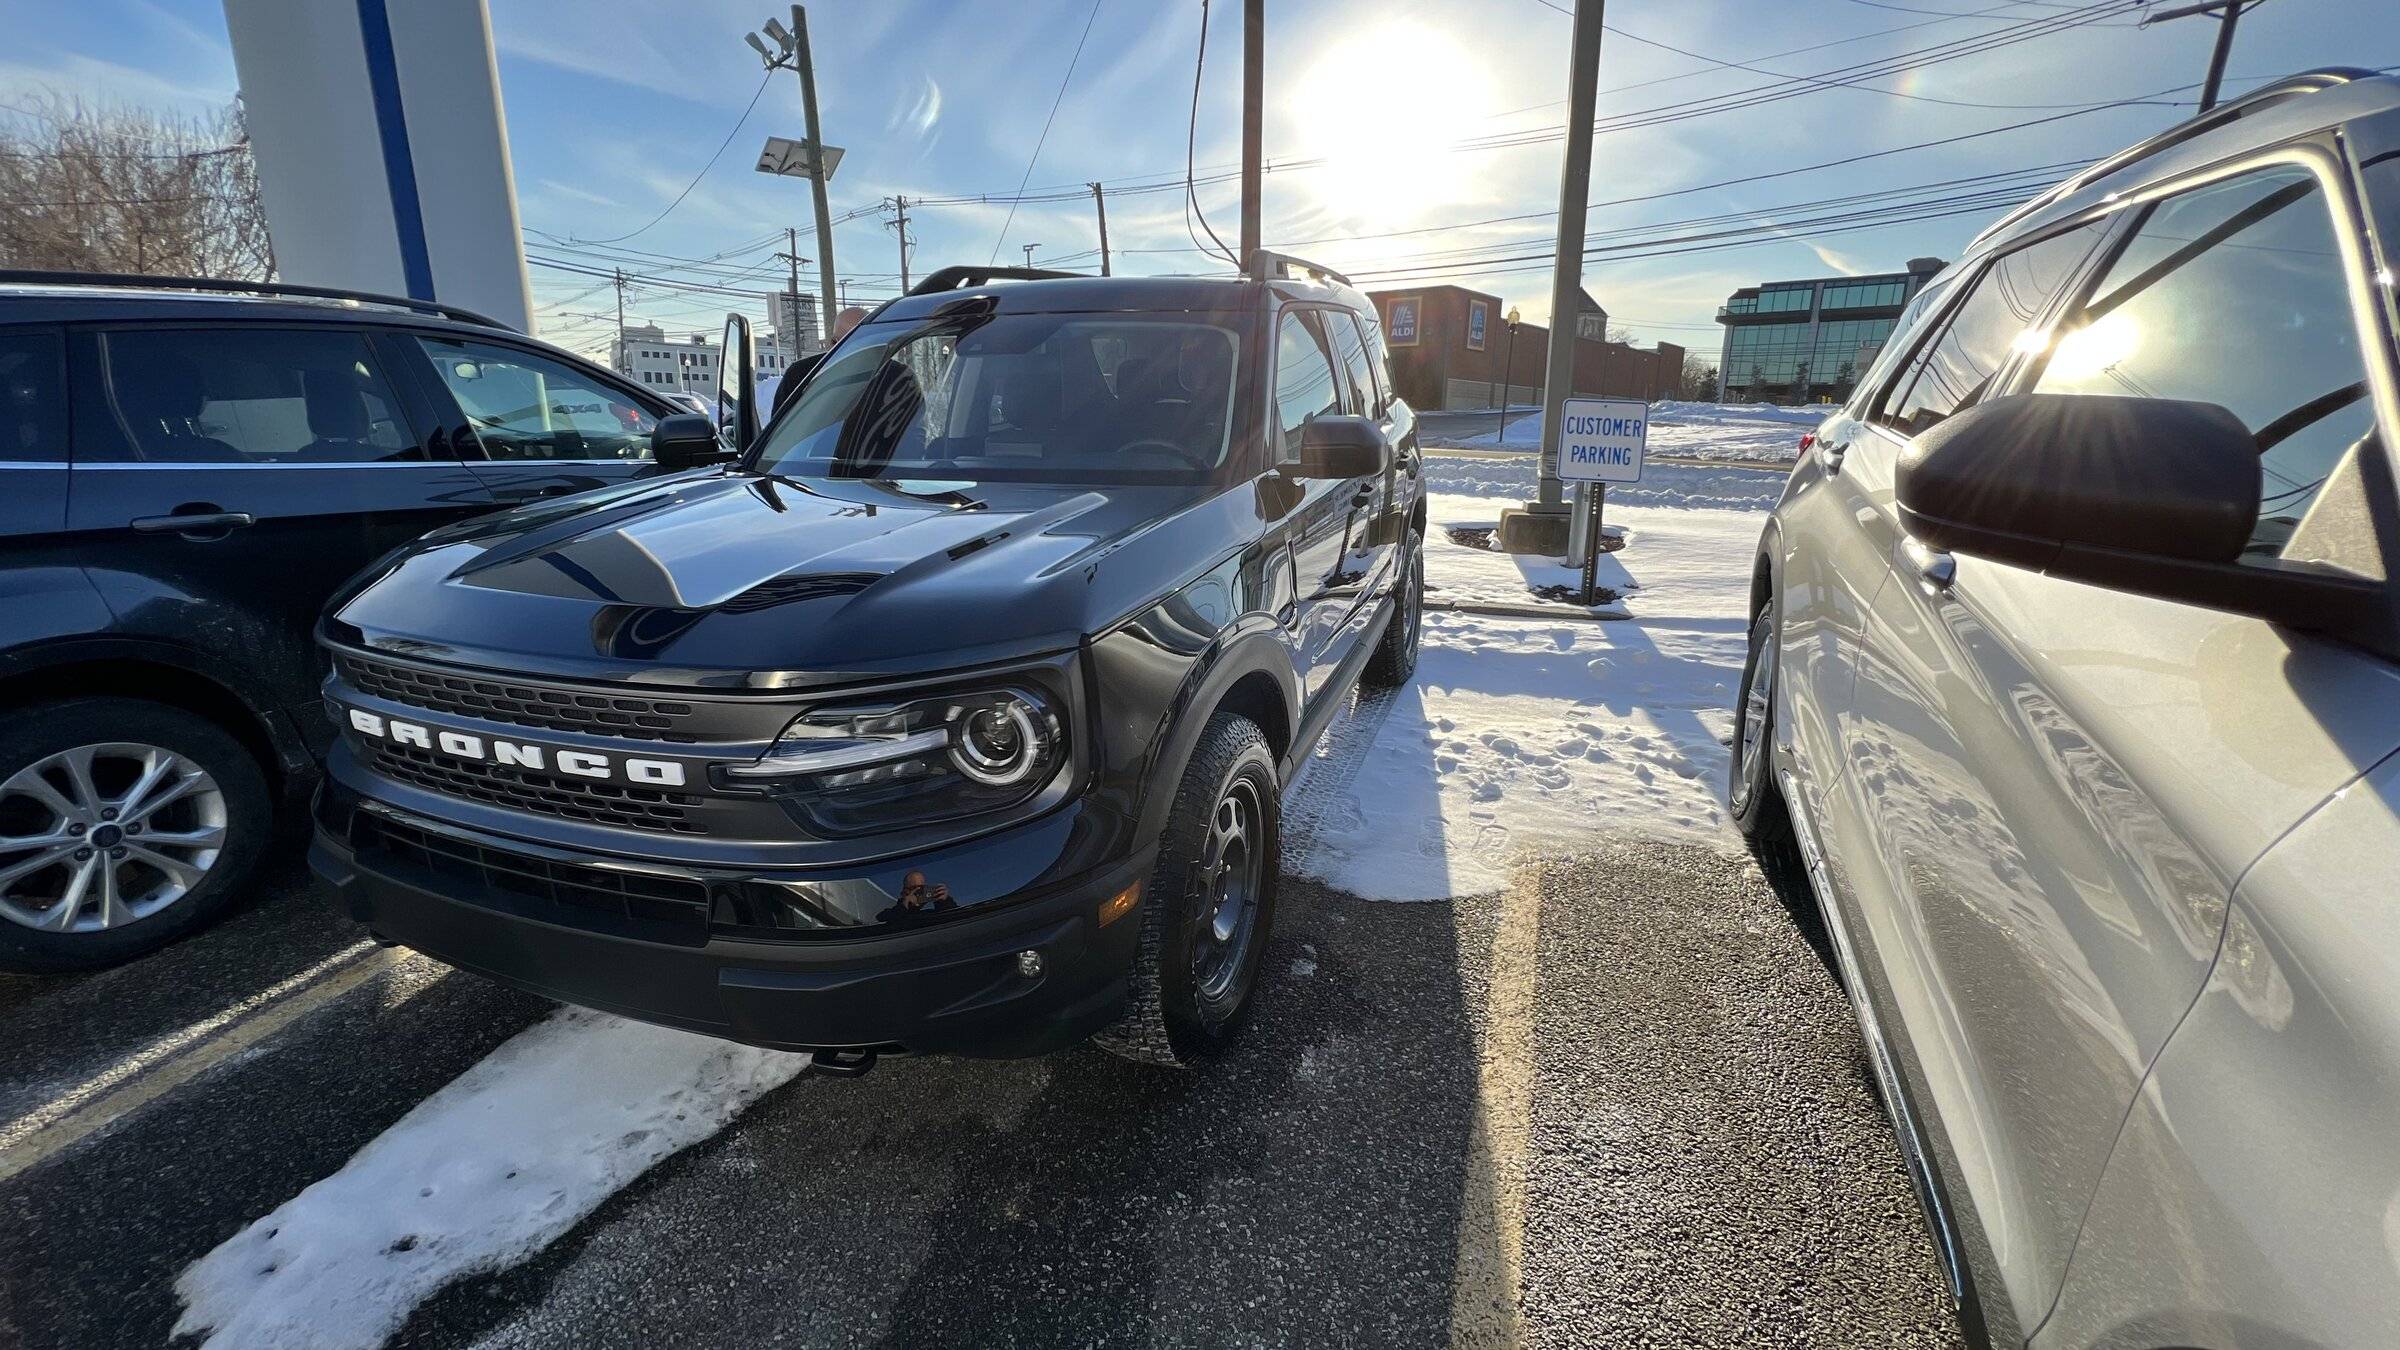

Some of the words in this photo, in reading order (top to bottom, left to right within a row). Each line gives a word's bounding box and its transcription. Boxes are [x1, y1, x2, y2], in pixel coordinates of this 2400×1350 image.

[1391, 327, 1414, 337] ALDI
[1566, 416, 1642, 437] CUSTOMER
[1570, 445, 1632, 466] PARKING
[350, 709, 686, 786] BRONCO
